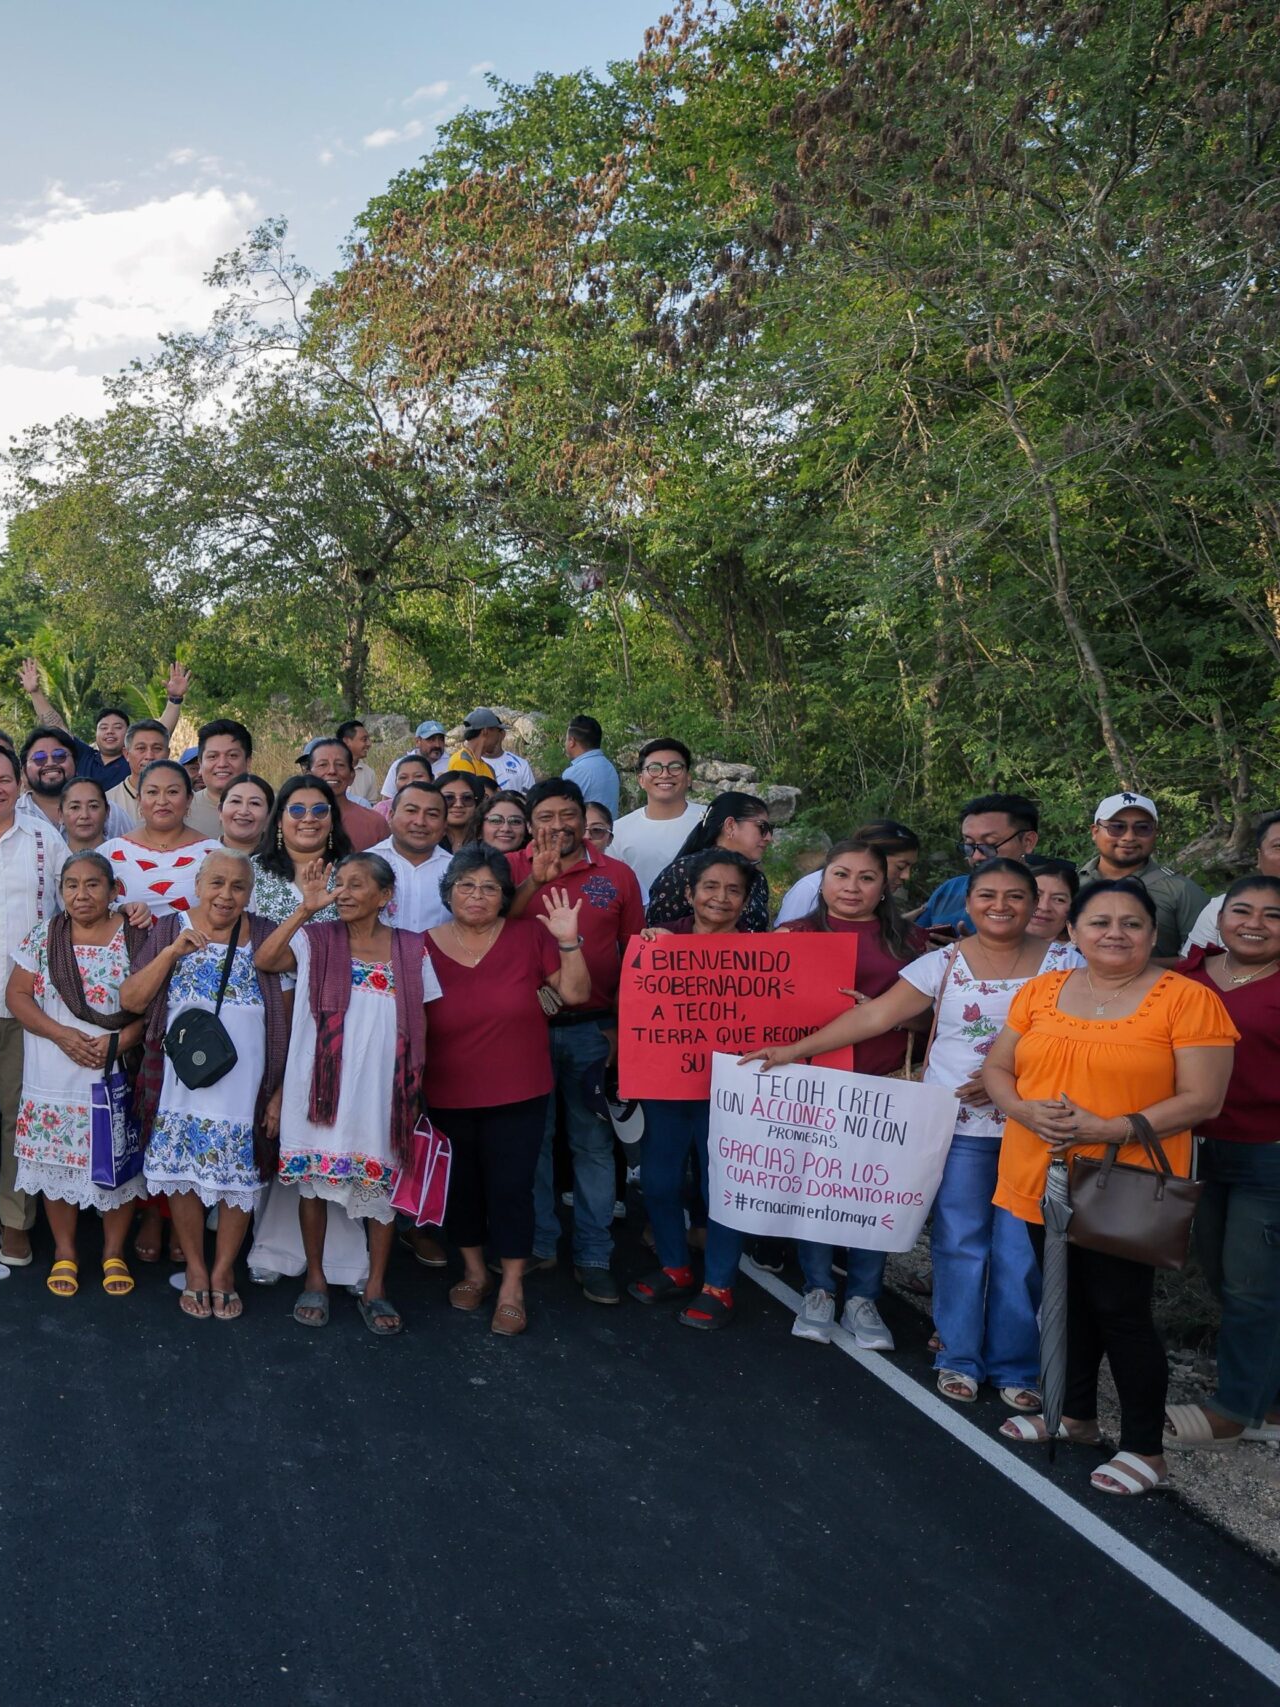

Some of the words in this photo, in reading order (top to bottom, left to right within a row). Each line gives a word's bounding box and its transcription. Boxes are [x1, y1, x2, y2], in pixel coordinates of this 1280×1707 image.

[644, 974, 781, 999] GOBERNADOR
[651, 1005, 665, 1021] A
[673, 1001, 746, 1023] TECOH,
[631, 1027, 708, 1044] TIERRA
[716, 1026, 756, 1044] QUE
[680, 1053, 706, 1073] SU
[752, 1072, 825, 1106] TECOH
[838, 1084, 896, 1119] CRECE
[716, 1087, 744, 1115] CON
[750, 1096, 836, 1130] ACCIONES
[843, 1114, 867, 1139] NO
[872, 1119, 908, 1146] CON
[718, 1136, 795, 1175] GRACIAS
[802, 1151, 842, 1179] POR
[851, 1162, 889, 1186] LOS
[726, 1164, 802, 1194] CUARTOS
[734, 1192, 877, 1228] #renacimientomaya
